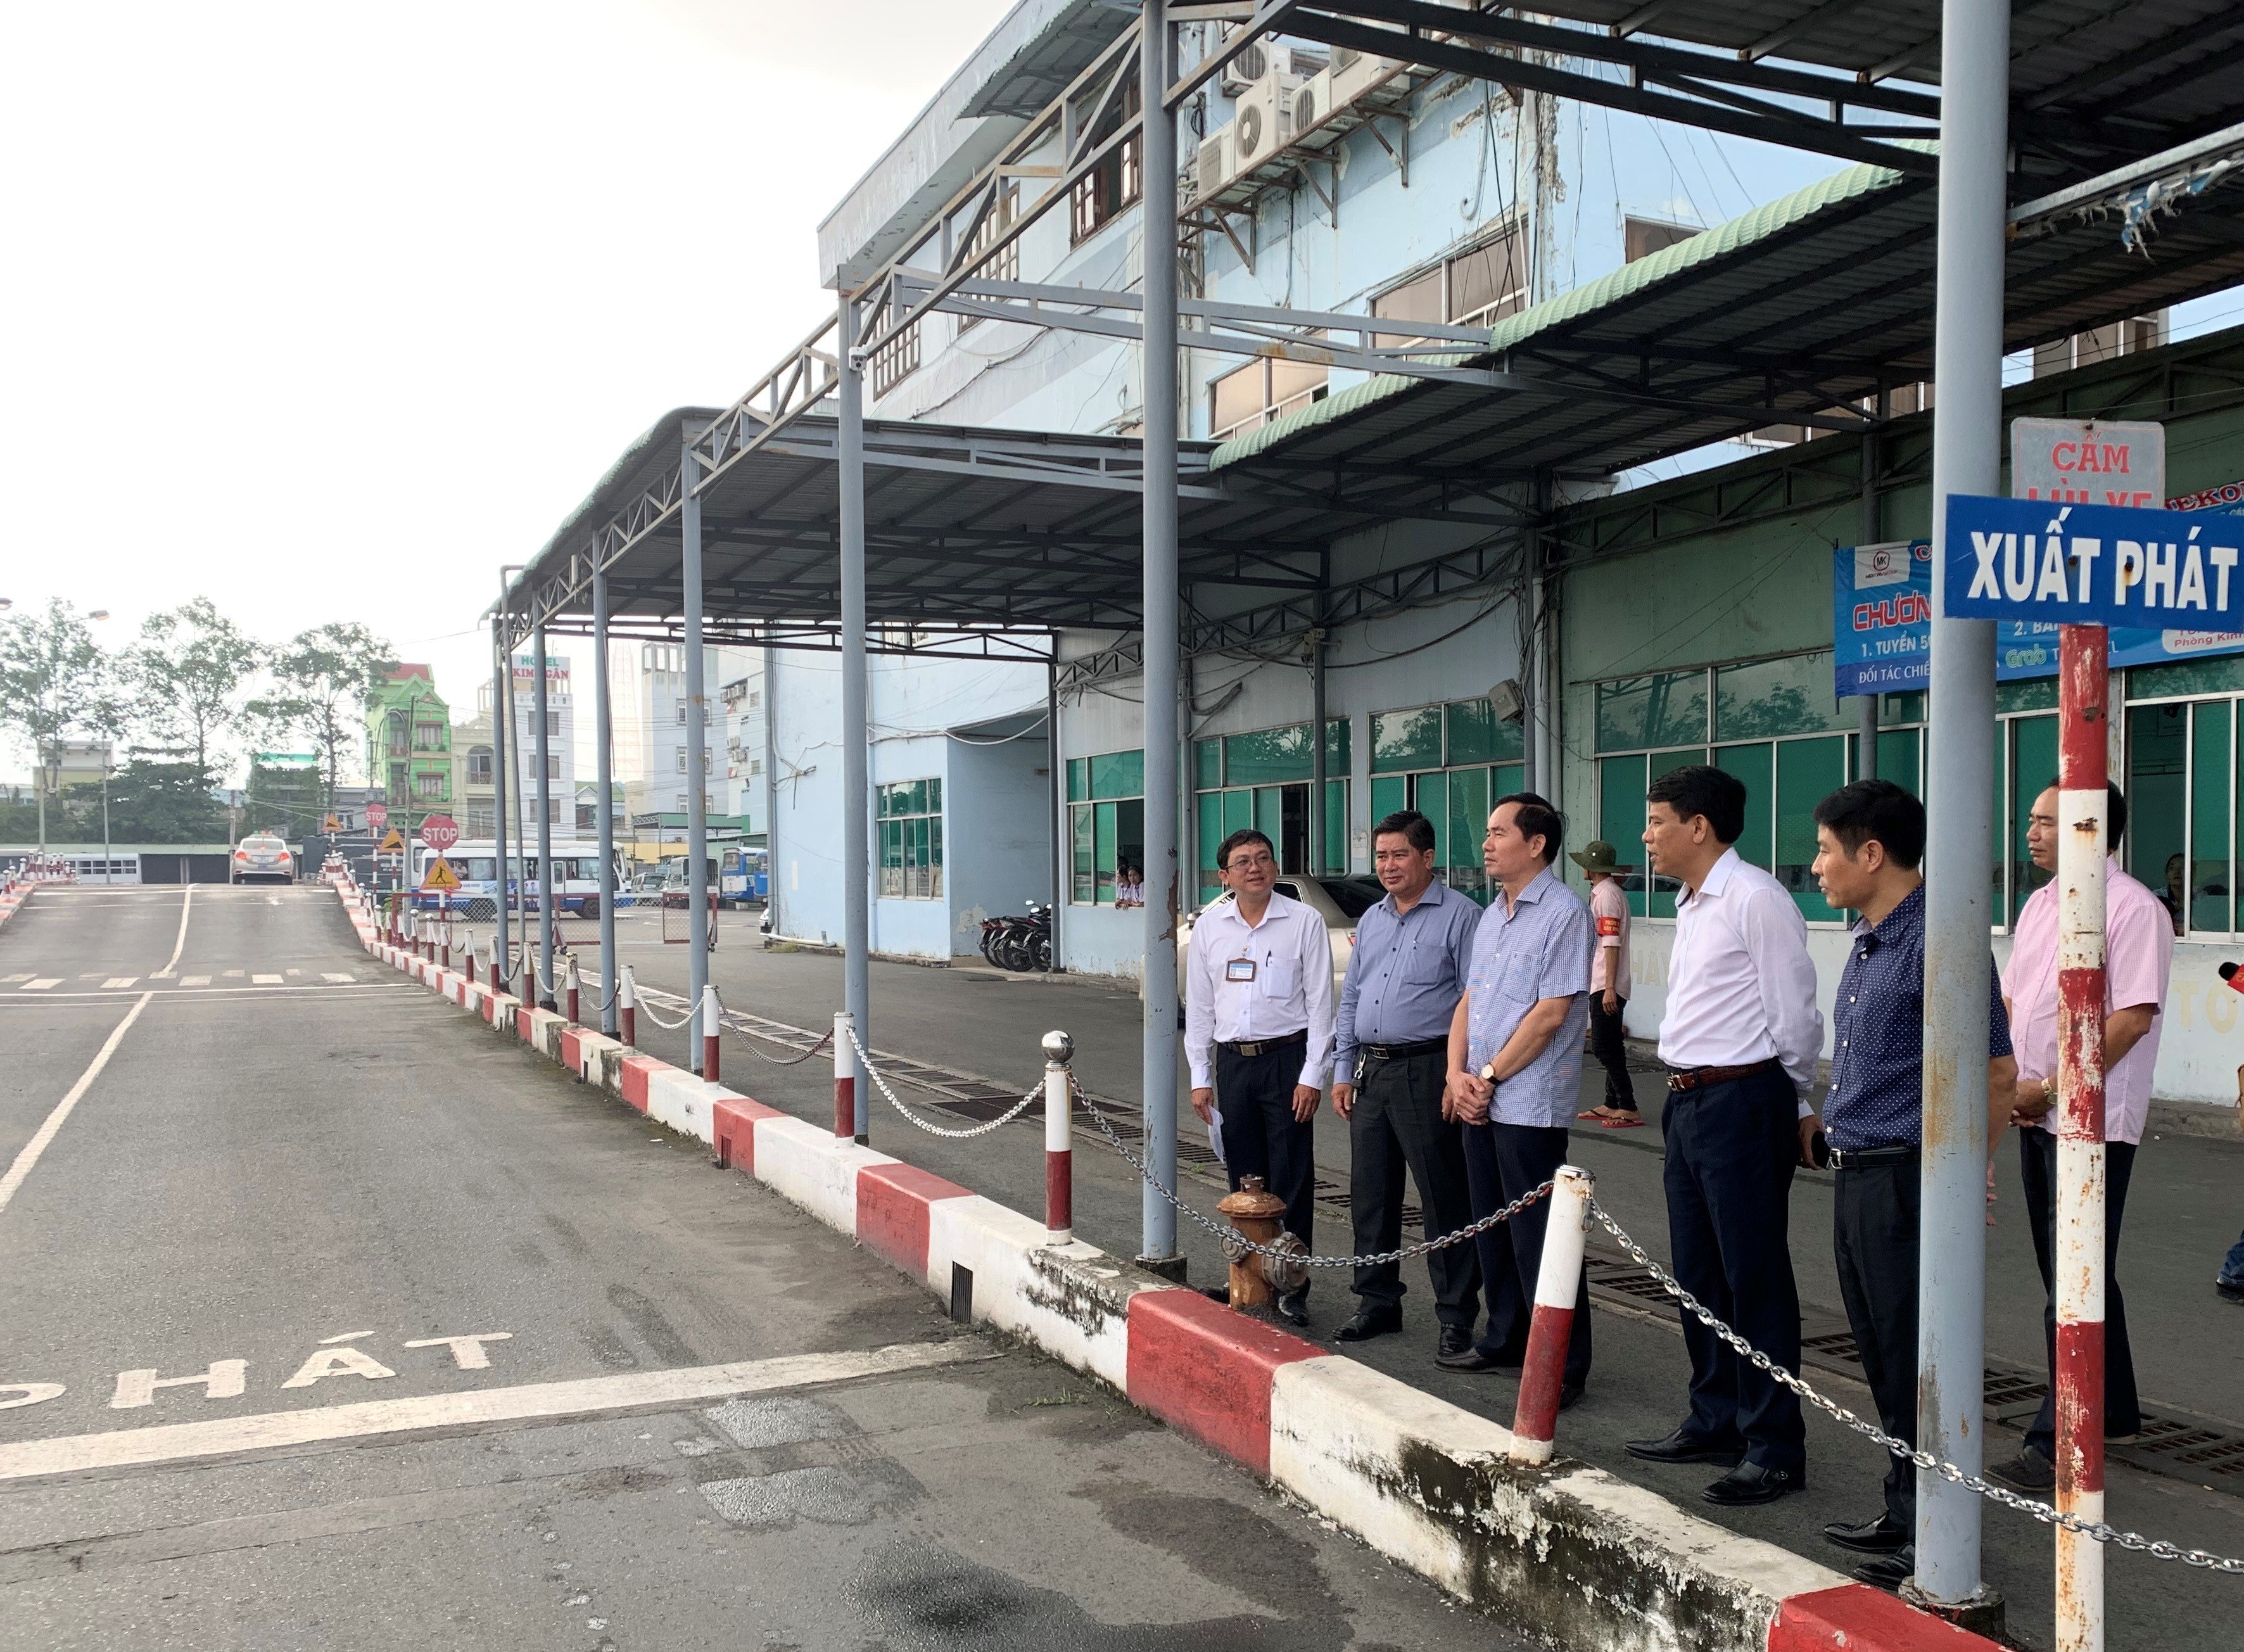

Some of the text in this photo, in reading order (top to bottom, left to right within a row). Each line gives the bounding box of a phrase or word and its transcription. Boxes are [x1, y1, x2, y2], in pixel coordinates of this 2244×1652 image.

[2051, 431, 2131, 474] CẤM
[2165, 480, 2244, 512] EKO
[1967, 507, 2238, 611] XUẤT PHÁT
[2013, 620, 2027, 637] 2.
[1862, 630, 1931, 658] 1. TUYỂN 5
[2174, 636, 2213, 647] Phòng
[521, 656, 559, 667] HOEL
[2005, 643, 2047, 668] Grab
[512, 668, 569, 679] KIM GÂN
[1858, 664, 1878, 684] ĐỐI
[1880, 665, 1902, 682] TÁC
[366, 811, 387, 822] STOP
[422, 827, 458, 842] STOP
